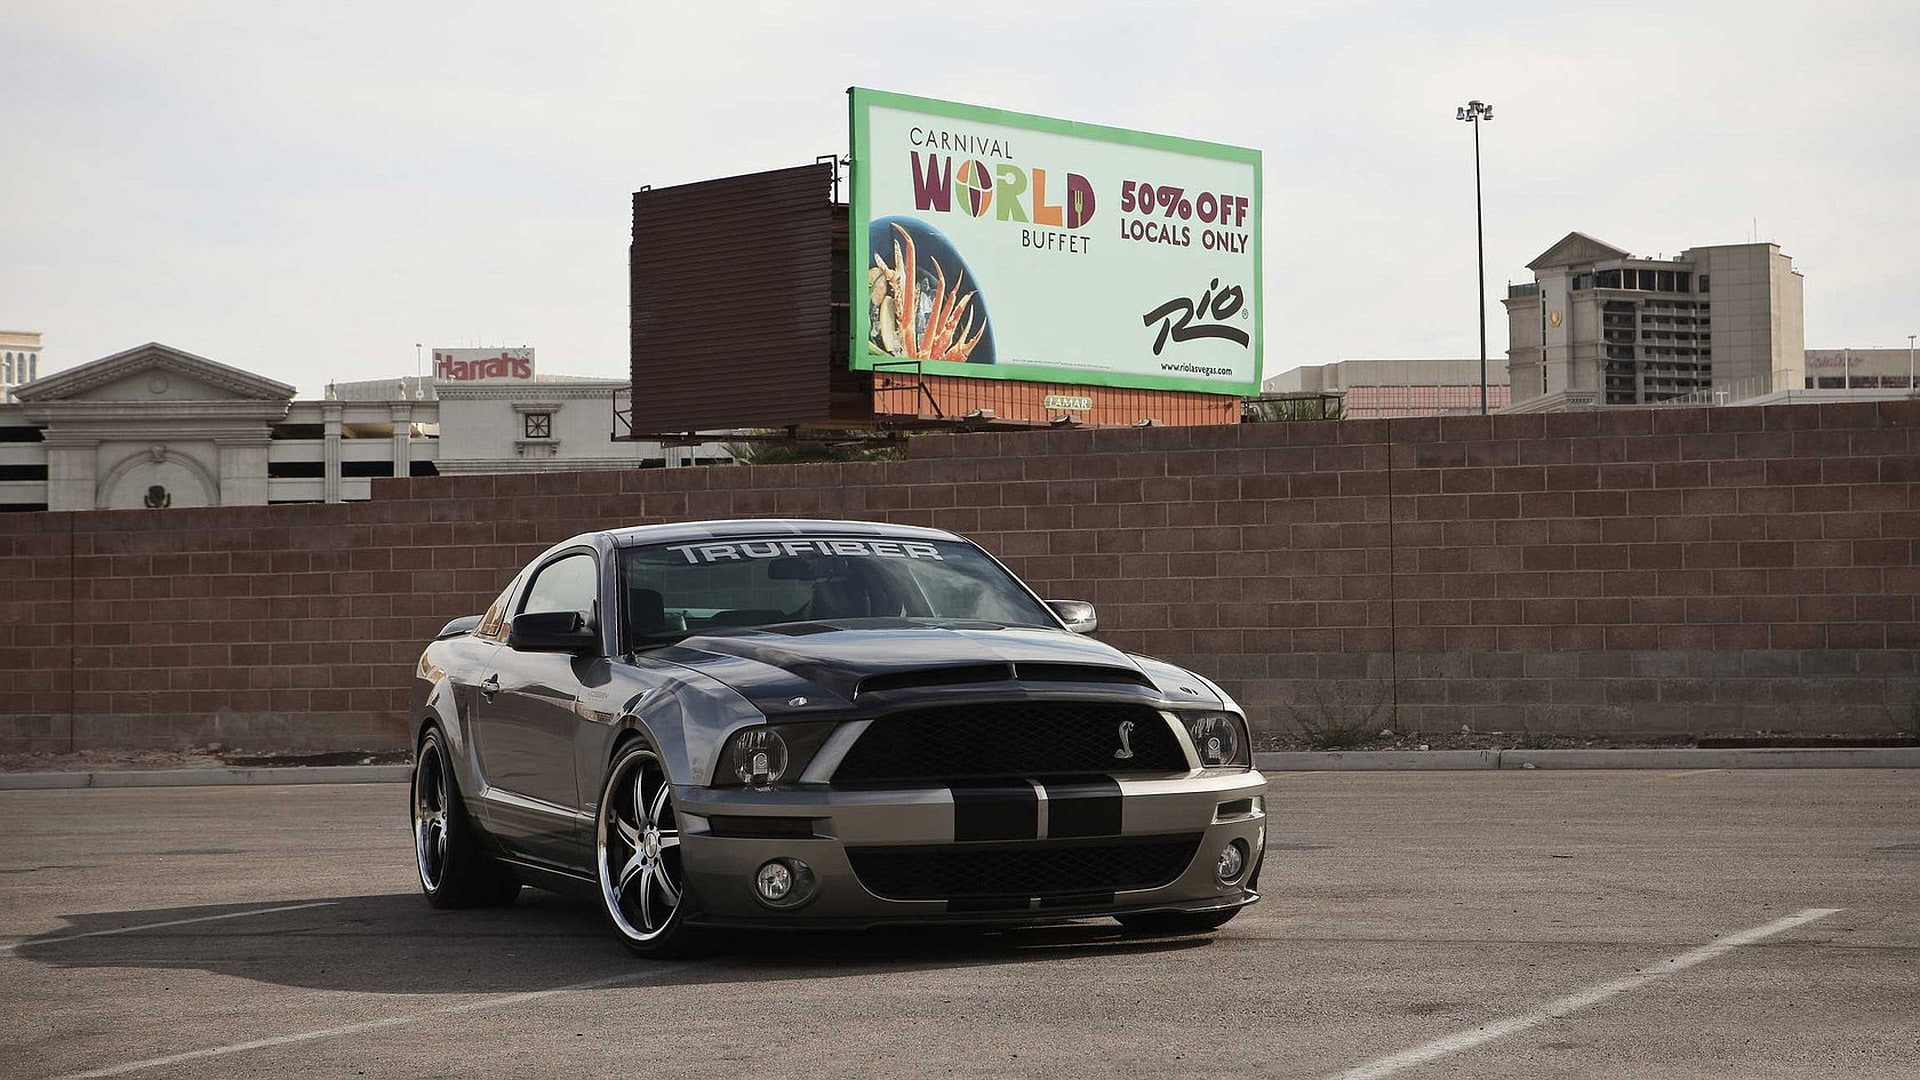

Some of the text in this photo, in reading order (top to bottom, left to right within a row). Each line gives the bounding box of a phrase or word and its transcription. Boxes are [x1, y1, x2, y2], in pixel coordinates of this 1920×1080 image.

[910, 127, 1013, 159] CARNIVAL
[910, 151, 1096, 230] WORLD
[1121, 180, 1249, 227] 50% OFF
[1022, 229, 1090, 254] BUFFET
[1121, 218, 1248, 254] LOCALS ONLY
[1161, 362, 1233, 377] www.riolasvegas.com
[1049, 397, 1088, 409] LAMAR
[666, 541, 944, 565] TRUFIBER
